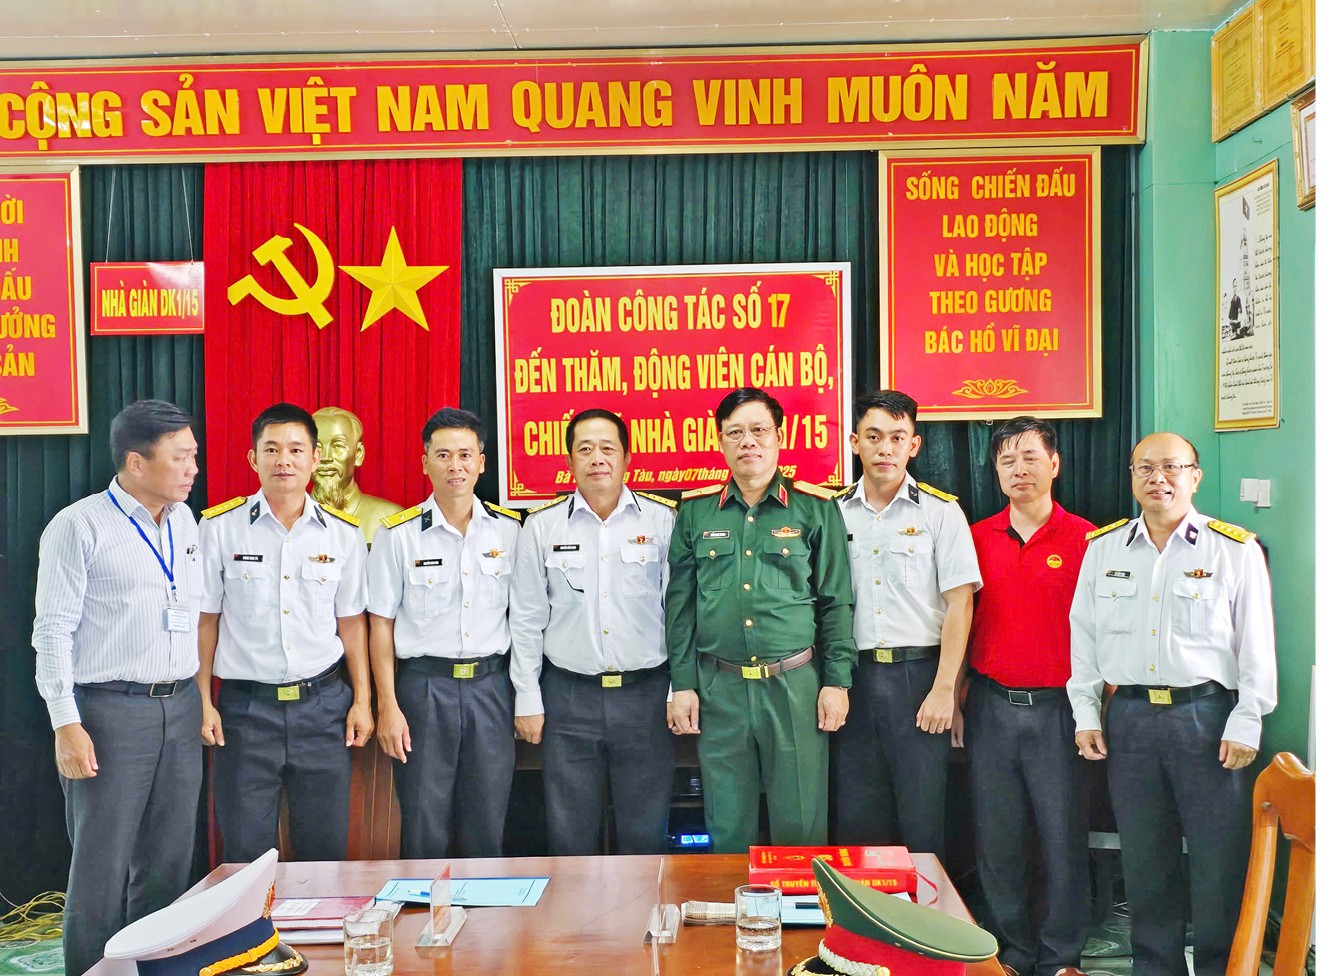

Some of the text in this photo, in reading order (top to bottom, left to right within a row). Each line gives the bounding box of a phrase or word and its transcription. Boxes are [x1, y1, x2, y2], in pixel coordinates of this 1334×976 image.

[0, 61, 1108, 151] CỘNG SẢN VIỆT NAM QUANG VINH MUÔN NĂM
[905, 166, 1076, 200] SỐNG CHIẾN ĐẤU
[0, 194, 24, 225] ỜI
[942, 207, 1038, 242] LAO ĐỘNG
[934, 247, 1048, 282] VÀ HỌC TẬP
[0, 267, 32, 301] ẤU
[101, 280, 199, 320] NHÀ GIÀN DK1/15
[929, 286, 1052, 315] THEO GƯƠNG
[550, 280, 791, 334] ĐOÀN CÔNG TÁC SỐ 17
[924, 322, 1059, 357] BÁC HỒ VĨ ĐẠI
[0, 344, 35, 377] ẢN
[514, 344, 834, 399] ĐẾN THĂM, ĐỘNG VIÊN CÁN BỘ,
[630, 410, 677, 455] NHÀ
[683, 409, 720, 453] GIÀ
